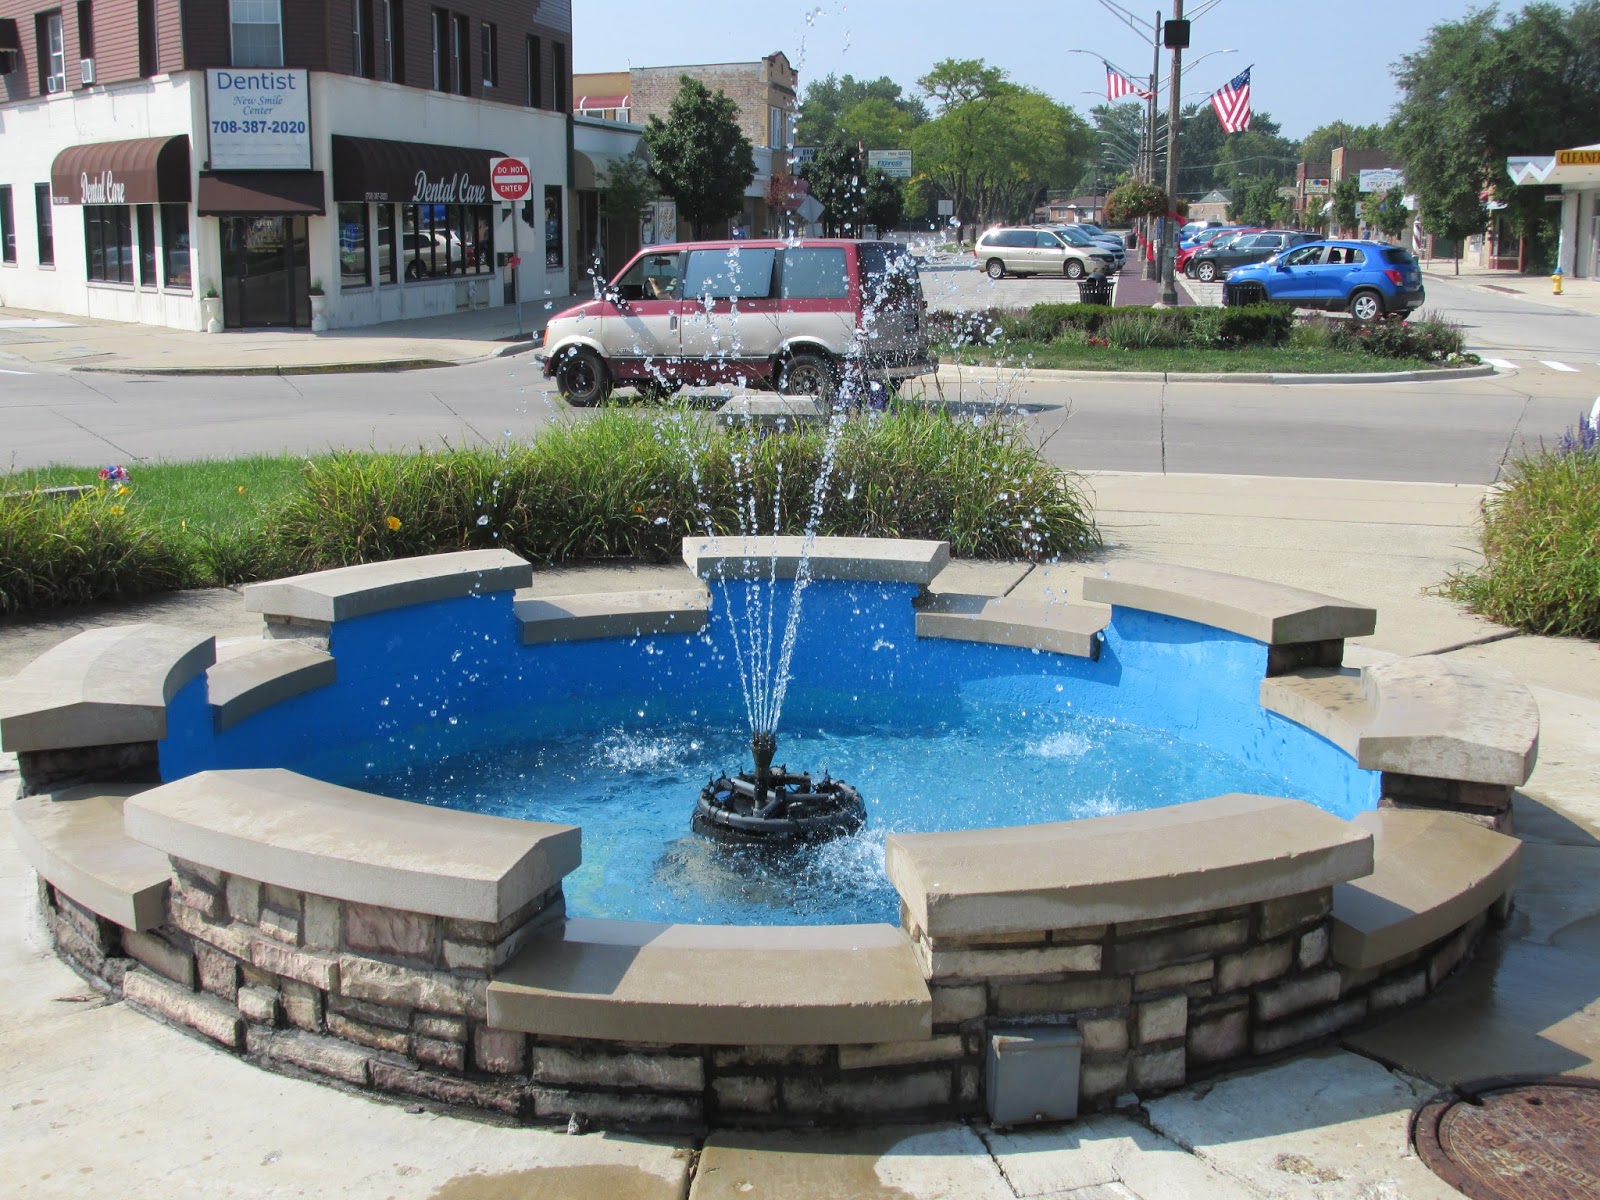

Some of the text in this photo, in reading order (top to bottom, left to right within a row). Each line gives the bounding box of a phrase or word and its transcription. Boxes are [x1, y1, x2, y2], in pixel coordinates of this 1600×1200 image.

[217, 72, 296, 90] Dentist
[233, 95, 283, 106] New Smile
[243, 106, 273, 116] Center
[212, 121, 306, 134] 708-387-2020
[1560, 151, 1600, 164] CLEANE
[497, 166, 524, 174] DO NOT
[81, 170, 125, 203] Dental Care
[413, 170, 486, 203] Dental Care
